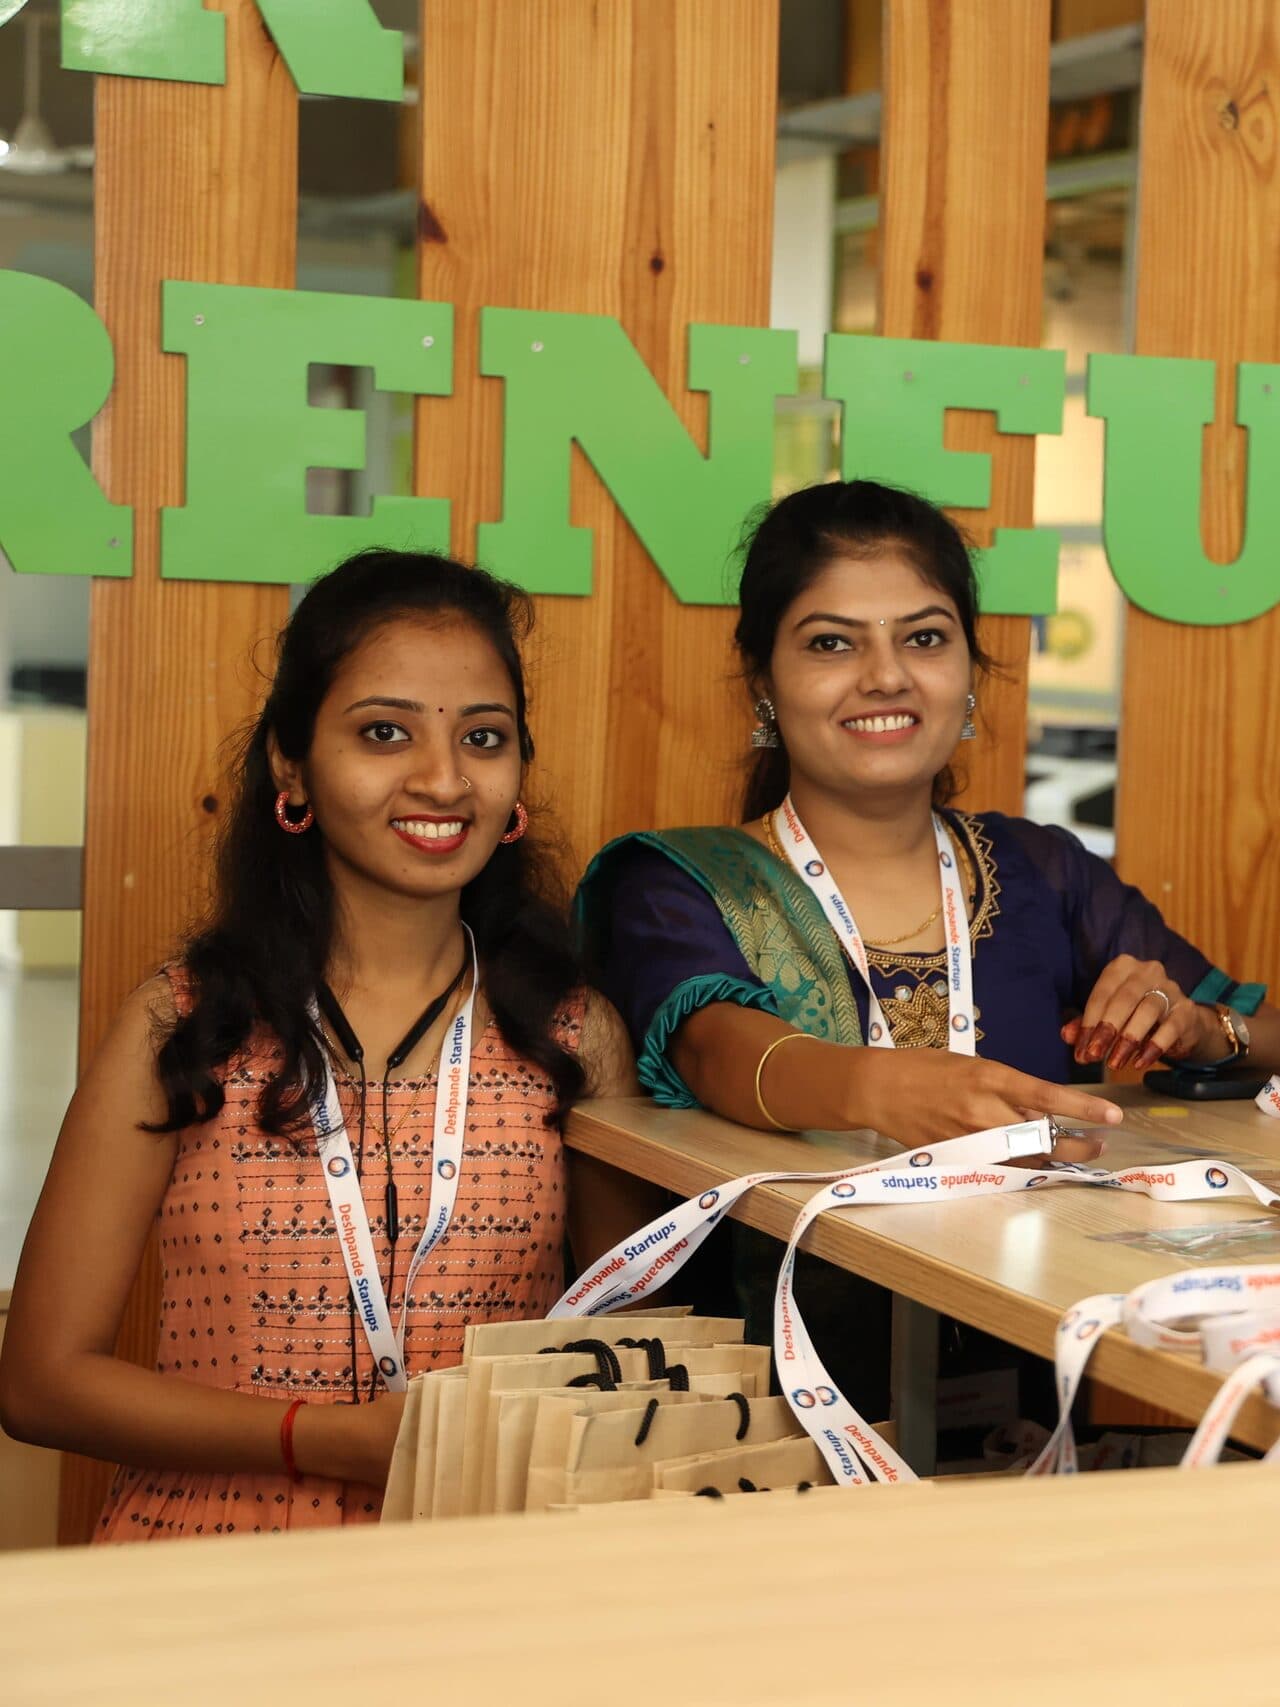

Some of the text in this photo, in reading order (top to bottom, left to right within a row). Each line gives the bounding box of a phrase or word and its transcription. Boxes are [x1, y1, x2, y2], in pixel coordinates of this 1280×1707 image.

[830, 893, 856, 935] Startups
[946, 887, 961, 991] Deshpande Startups
[443, 1014, 465, 1136] Deshpande Startups
[882, 1170, 1006, 1190] Deshpande Startups
[336, 1203, 380, 1333] Deshpande Startups
[565, 1220, 678, 1306] Deshpande Startups
[629, 1237, 689, 1294] Deshpande
[783, 1278, 796, 1360] Deshpande
[823, 1427, 857, 1478] Startups
[844, 1423, 899, 1484] Deshpande
